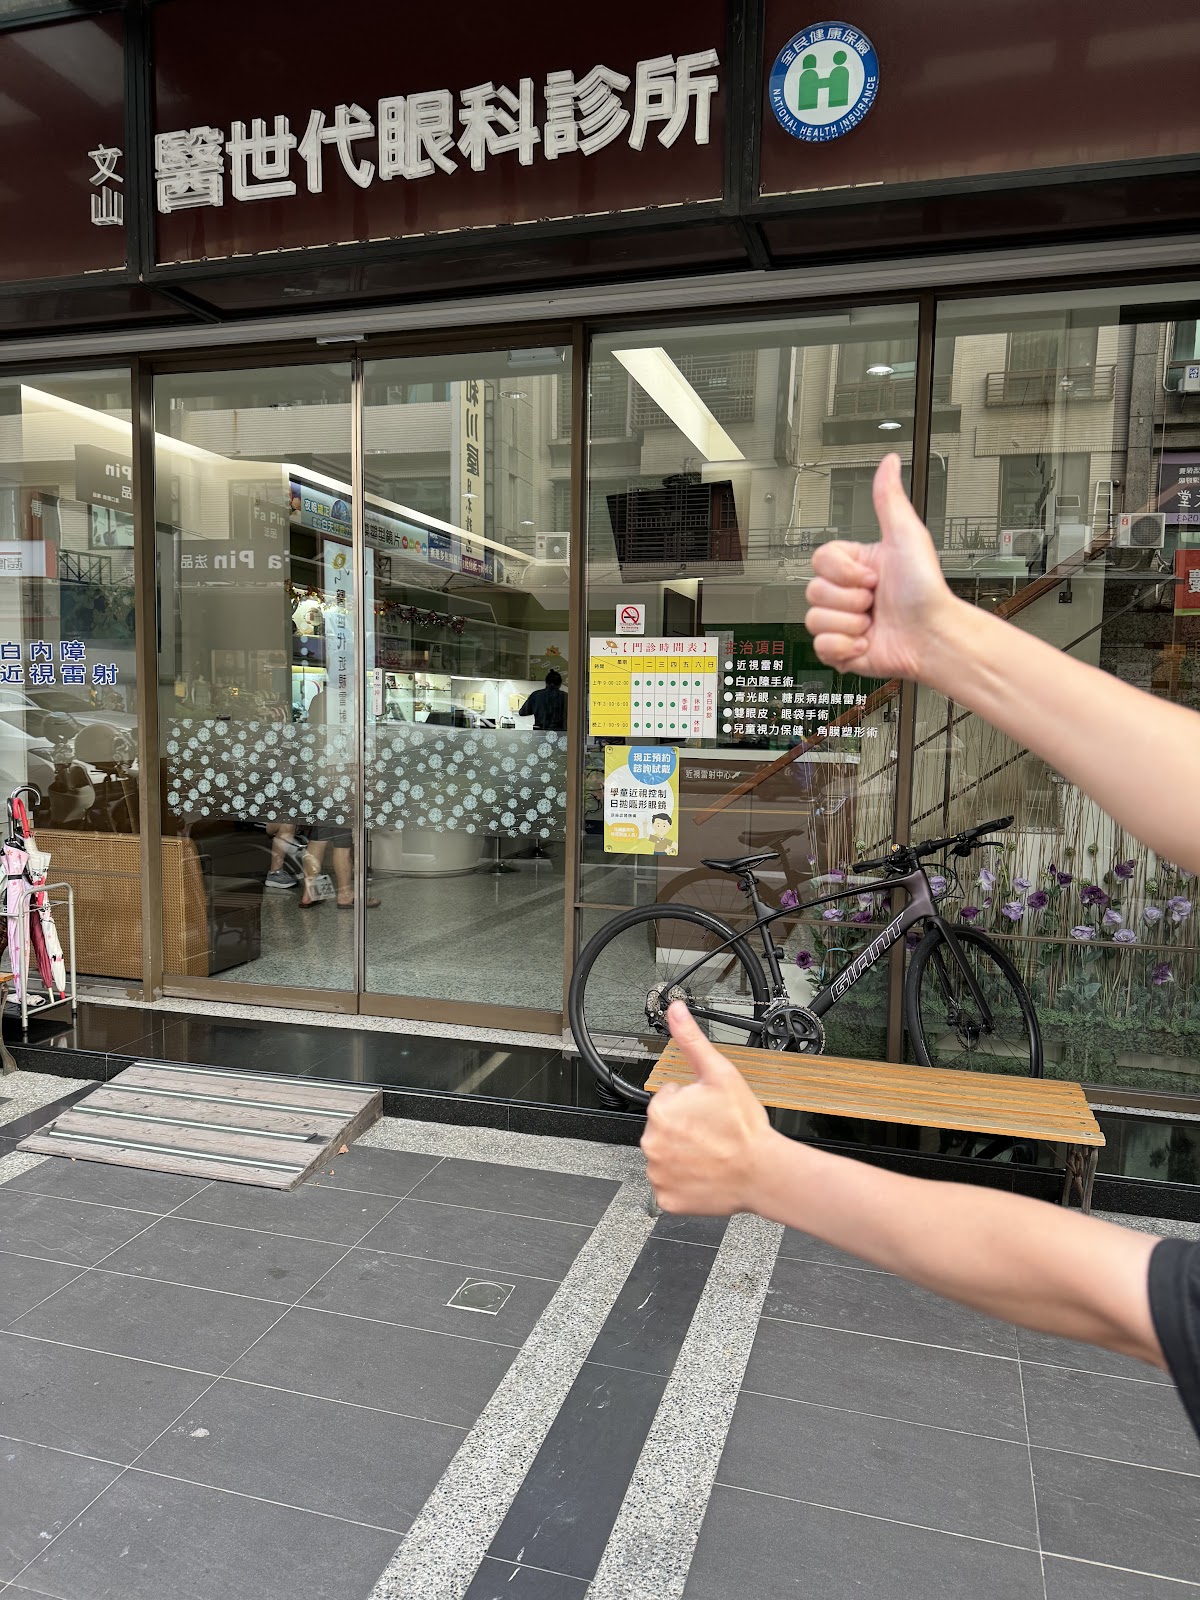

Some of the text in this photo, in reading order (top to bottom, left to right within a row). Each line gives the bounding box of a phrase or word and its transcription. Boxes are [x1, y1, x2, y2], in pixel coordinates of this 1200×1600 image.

[780, 27, 871, 67] 全民健康保險
[772, 75, 876, 137] NATIONAL HEALTH INSURANCE
[154, 48, 720, 214] 醫世代眼科診所
[88, 144, 124, 227] 文山
[724, 640, 785, 655] 主治項目
[736, 660, 784, 671] 近視雷射
[0, 664, 118, 684] 近視雷射
[734, 708, 829, 720] 雙眼皮、眼袋手術
[734, 724, 878, 738] 兒童視力保健、角膜塑形術
[633, 752, 671, 763] 現正預約
[633, 764, 671, 774] 諮詢試戴
[686, 769, 731, 779] 近視雷射中心
[610, 788, 667, 799] 學童近視控制
[610, 800, 667, 810] 日拋隱形眼鏡
[830, 911, 904, 1002] GIANT
